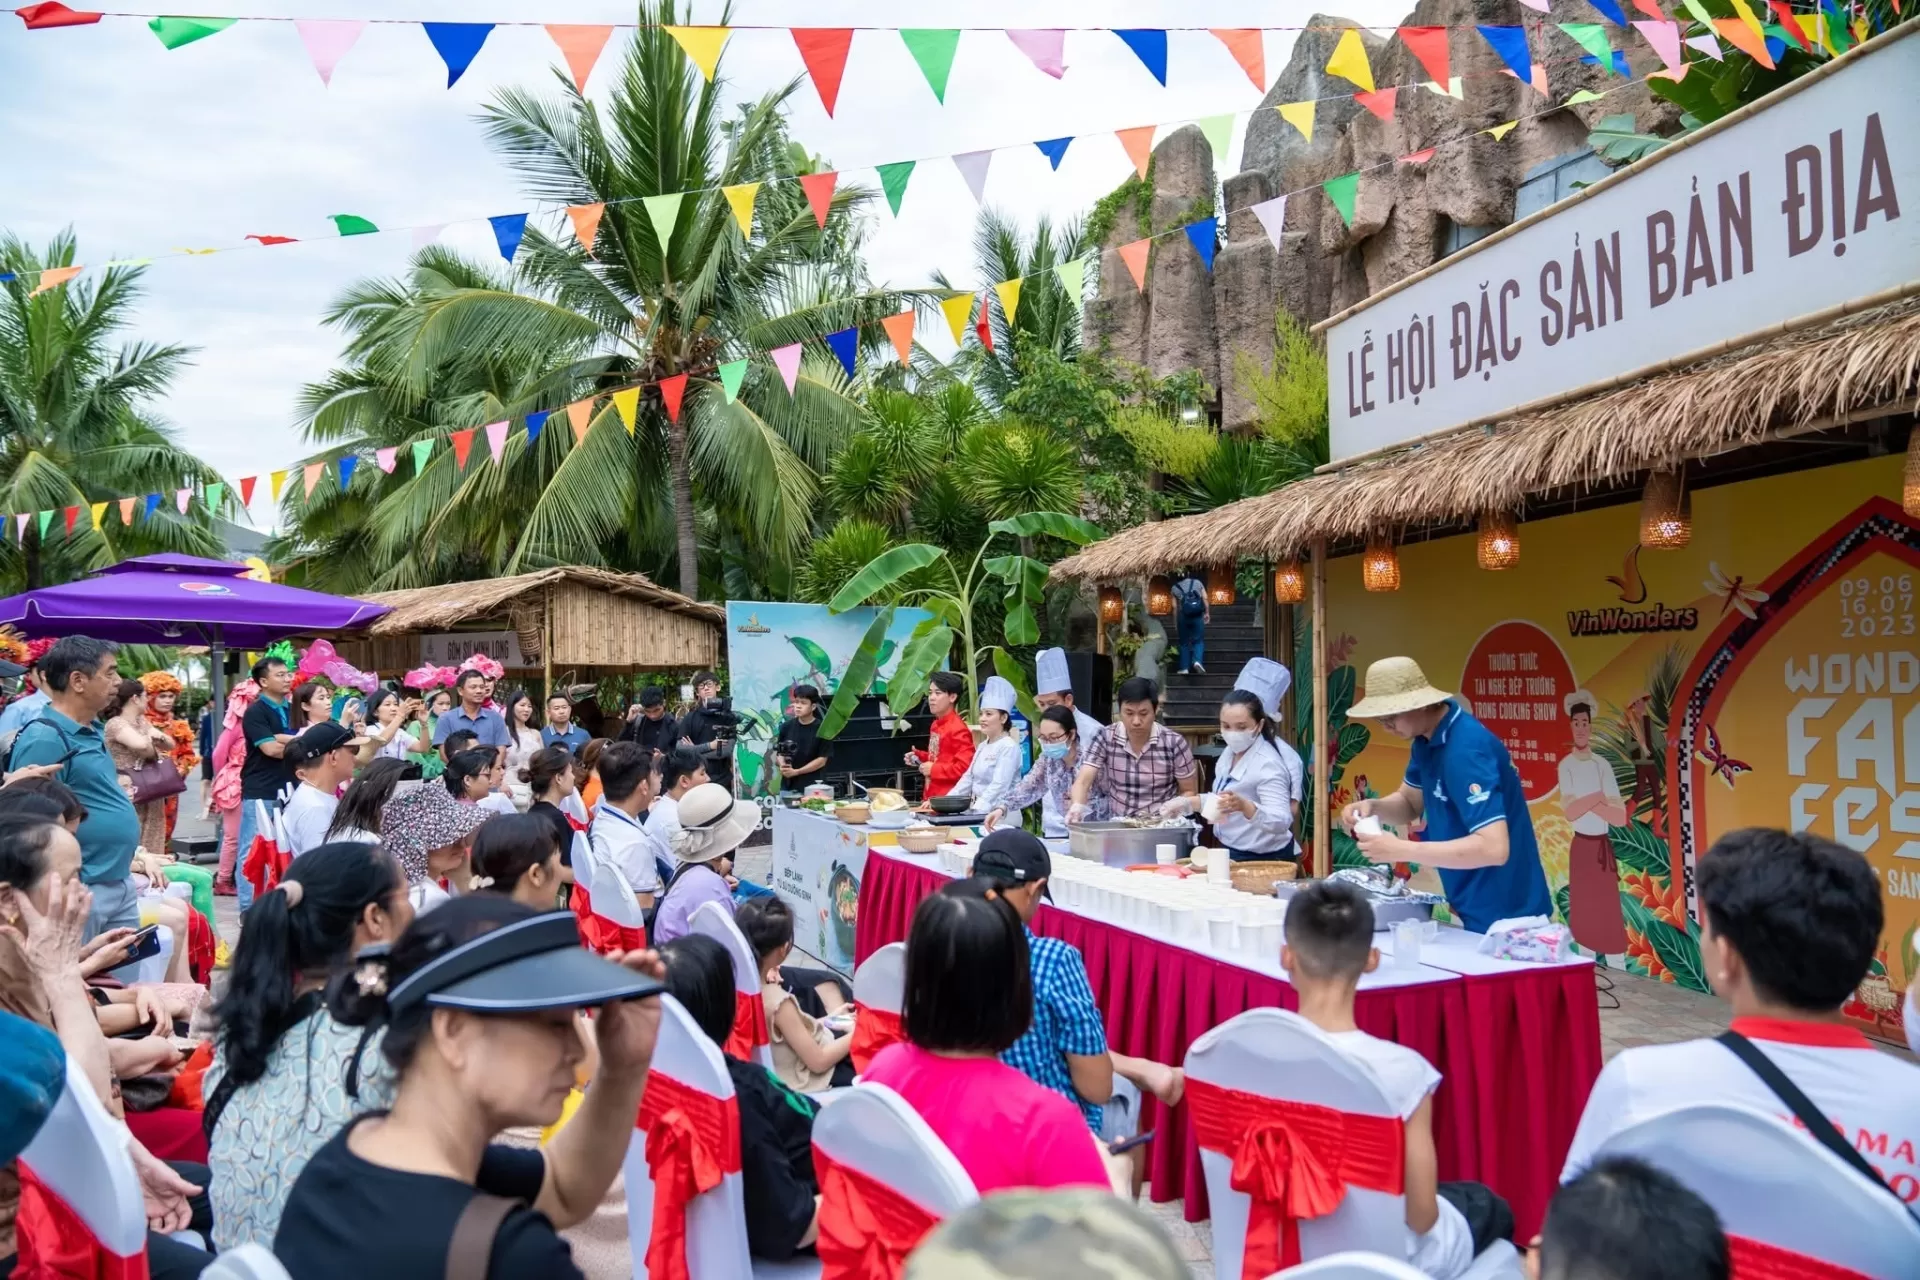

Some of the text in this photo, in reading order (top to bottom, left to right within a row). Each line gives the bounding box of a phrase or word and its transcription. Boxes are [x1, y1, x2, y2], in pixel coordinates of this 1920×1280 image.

[1347, 112, 1901, 418] LỄ HỘI ĐẶC SẢN BẢN ĐỊA
[1840, 574, 1912, 598] 09.06
[1840, 593, 1913, 616] 16.07
[1567, 603, 1698, 637] VinWonders
[1841, 614, 1916, 638] 2023
[492, 640, 509, 660] LONG
[1499, 702, 1531, 720] COOKING
[1533, 703, 1557, 721] SHOW
